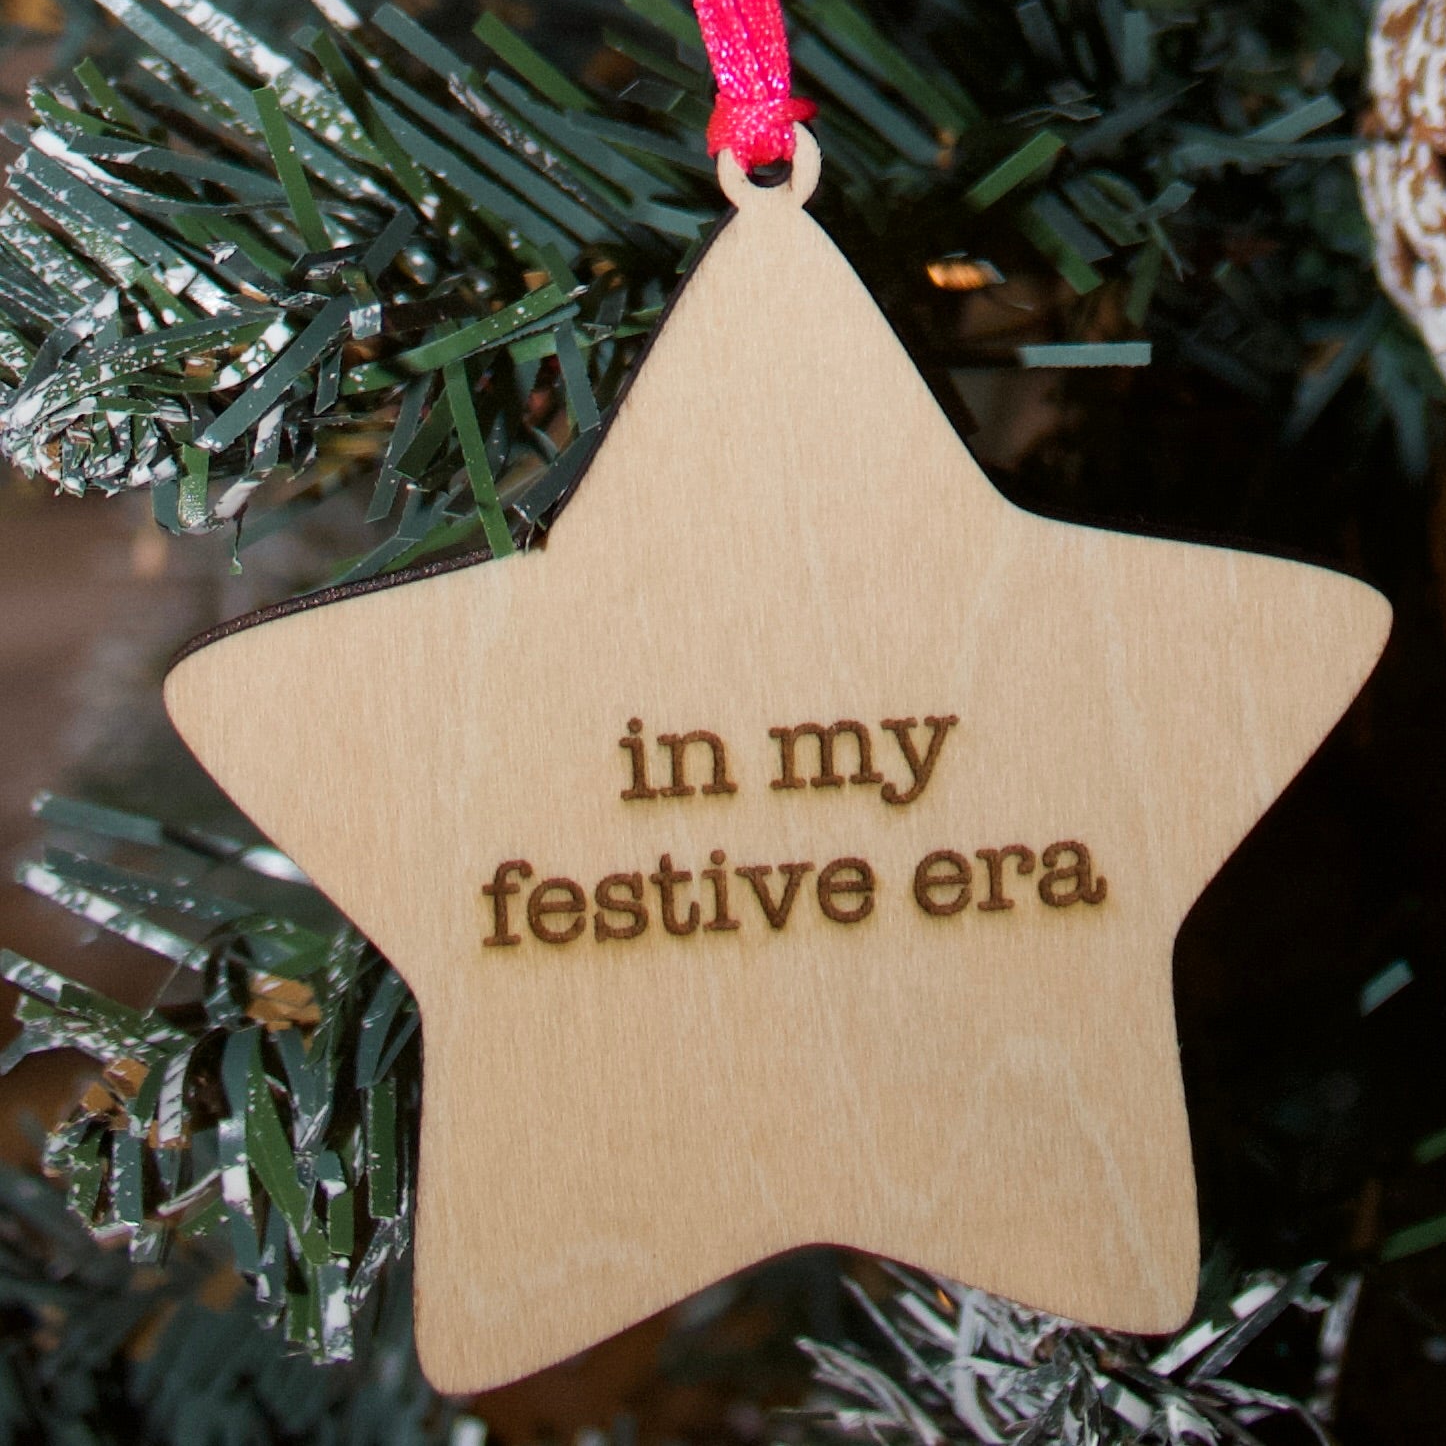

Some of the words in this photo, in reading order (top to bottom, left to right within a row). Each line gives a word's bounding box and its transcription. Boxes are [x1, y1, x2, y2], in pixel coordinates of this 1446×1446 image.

[617, 716, 739, 802] in
[767, 713, 961, 806] my
[481, 849, 877, 948] festive
[911, 839, 1108, 917] era
